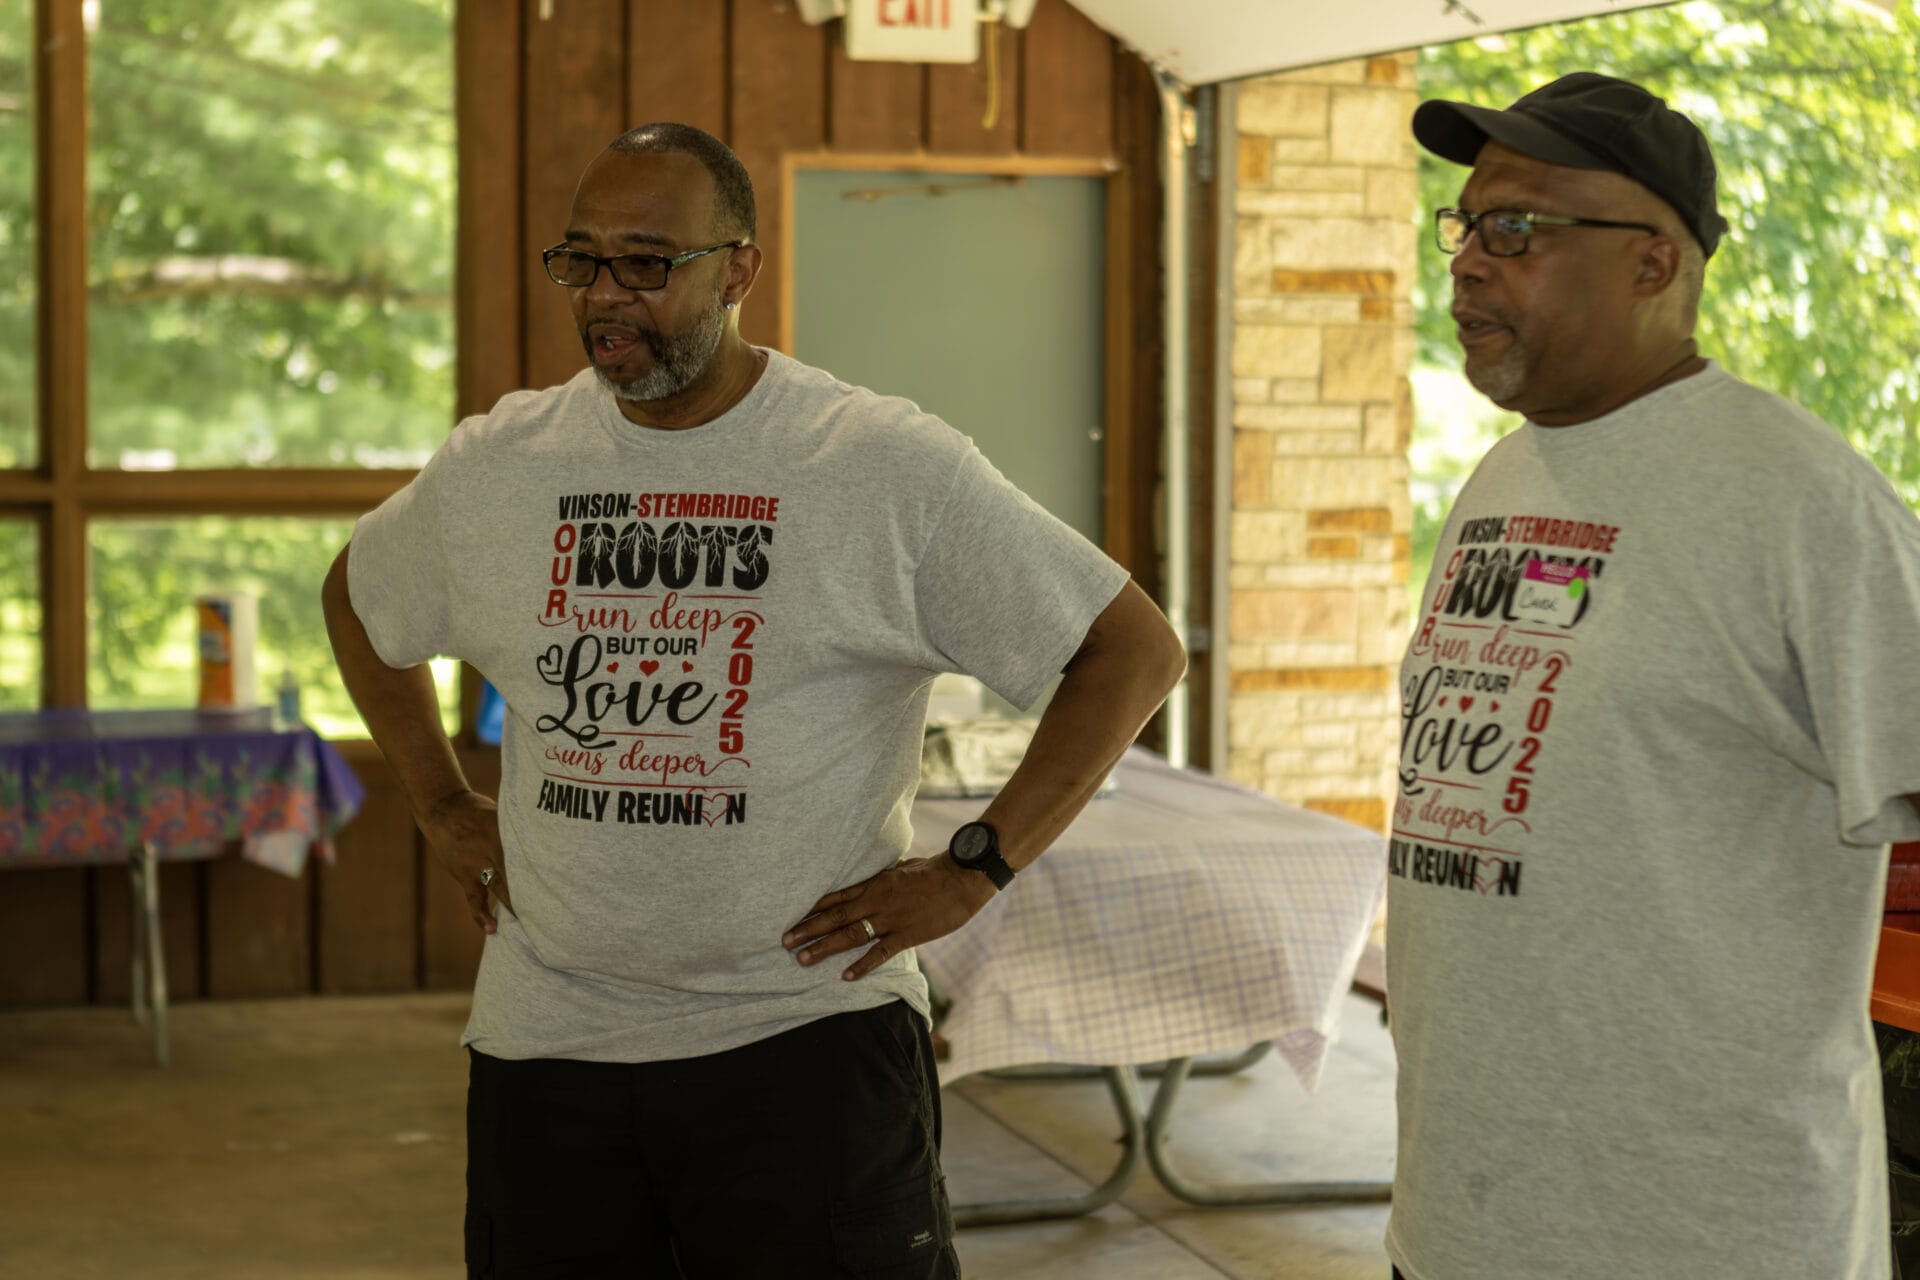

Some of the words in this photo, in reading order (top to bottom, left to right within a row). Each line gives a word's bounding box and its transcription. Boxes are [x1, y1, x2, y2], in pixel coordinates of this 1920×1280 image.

[559, 493, 780, 522] VINSON-STEMBRIDGE
[545, 523, 577, 619] OUR
[576, 521, 773, 591] ROOTS
[538, 604, 638, 634] run
[650, 592, 764, 649] deep
[606, 637, 649, 655] BUT
[653, 637, 698, 656] OUR
[1443, 668, 1475, 689] BUT
[1475, 672, 1511, 695] OUR
[1479, 624, 1571, 688] deep
[536, 634, 718, 749] Love
[718, 617, 756, 754] 2025
[619, 740, 750, 786] deeper
[1503, 657, 1565, 814] 2025
[537, 779, 610, 823] FAMILY
[1419, 788, 1532, 841] deeper
